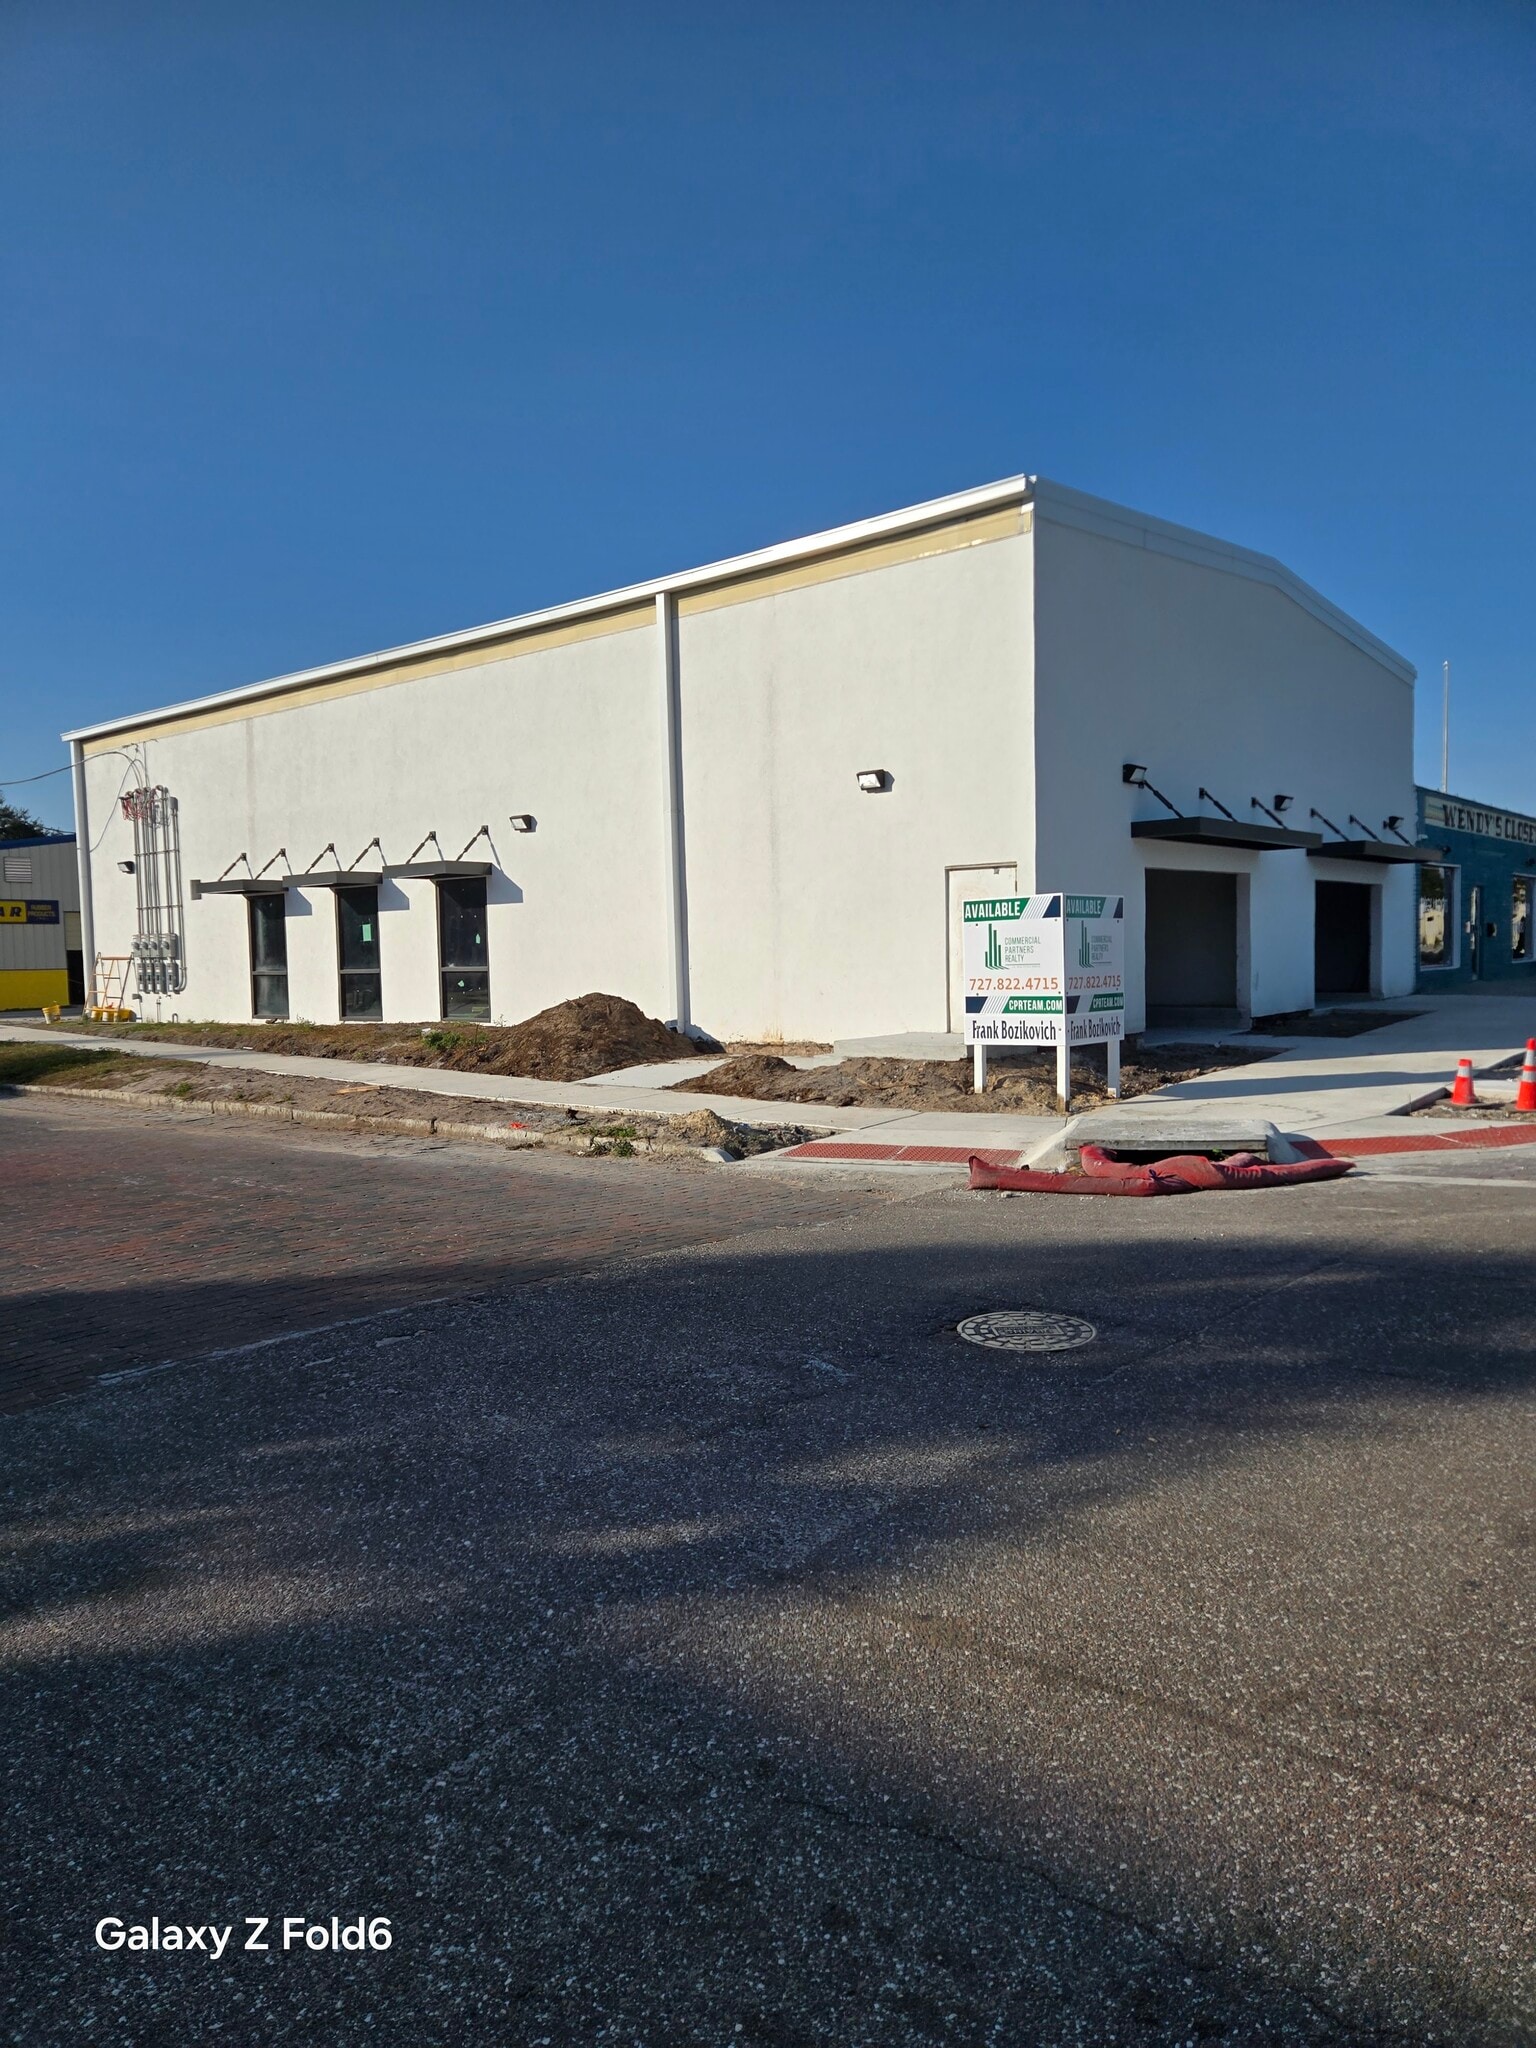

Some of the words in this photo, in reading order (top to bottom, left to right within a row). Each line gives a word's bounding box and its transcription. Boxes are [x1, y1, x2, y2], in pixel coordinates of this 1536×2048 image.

[1443, 803, 1502, 837] WENDY'S
[1504, 817, 1536, 844] CLOSE
[964, 901, 1021, 919] AVAILABLE
[1066, 899, 1101, 914] AVAILABLE
[1004, 936, 1041, 946] COMMERCIAL
[1004, 945, 1034, 954] PARTNERS
[1004, 954, 1024, 963] REALTY
[969, 977, 1059, 991] 727.822.4715
[1068, 975, 1121, 990] 727.822.4715
[1008, 999, 1063, 1011] CPRTEAM.COM
[1092, 996, 1123, 1008] CPRTEAM.COM
[972, 1020, 999, 1039] Frank
[1001, 1020, 1057, 1040] Bozikovich
[1070, 1020, 1087, 1040] Frank
[1088, 1016, 1121, 1038] Bozikovich
